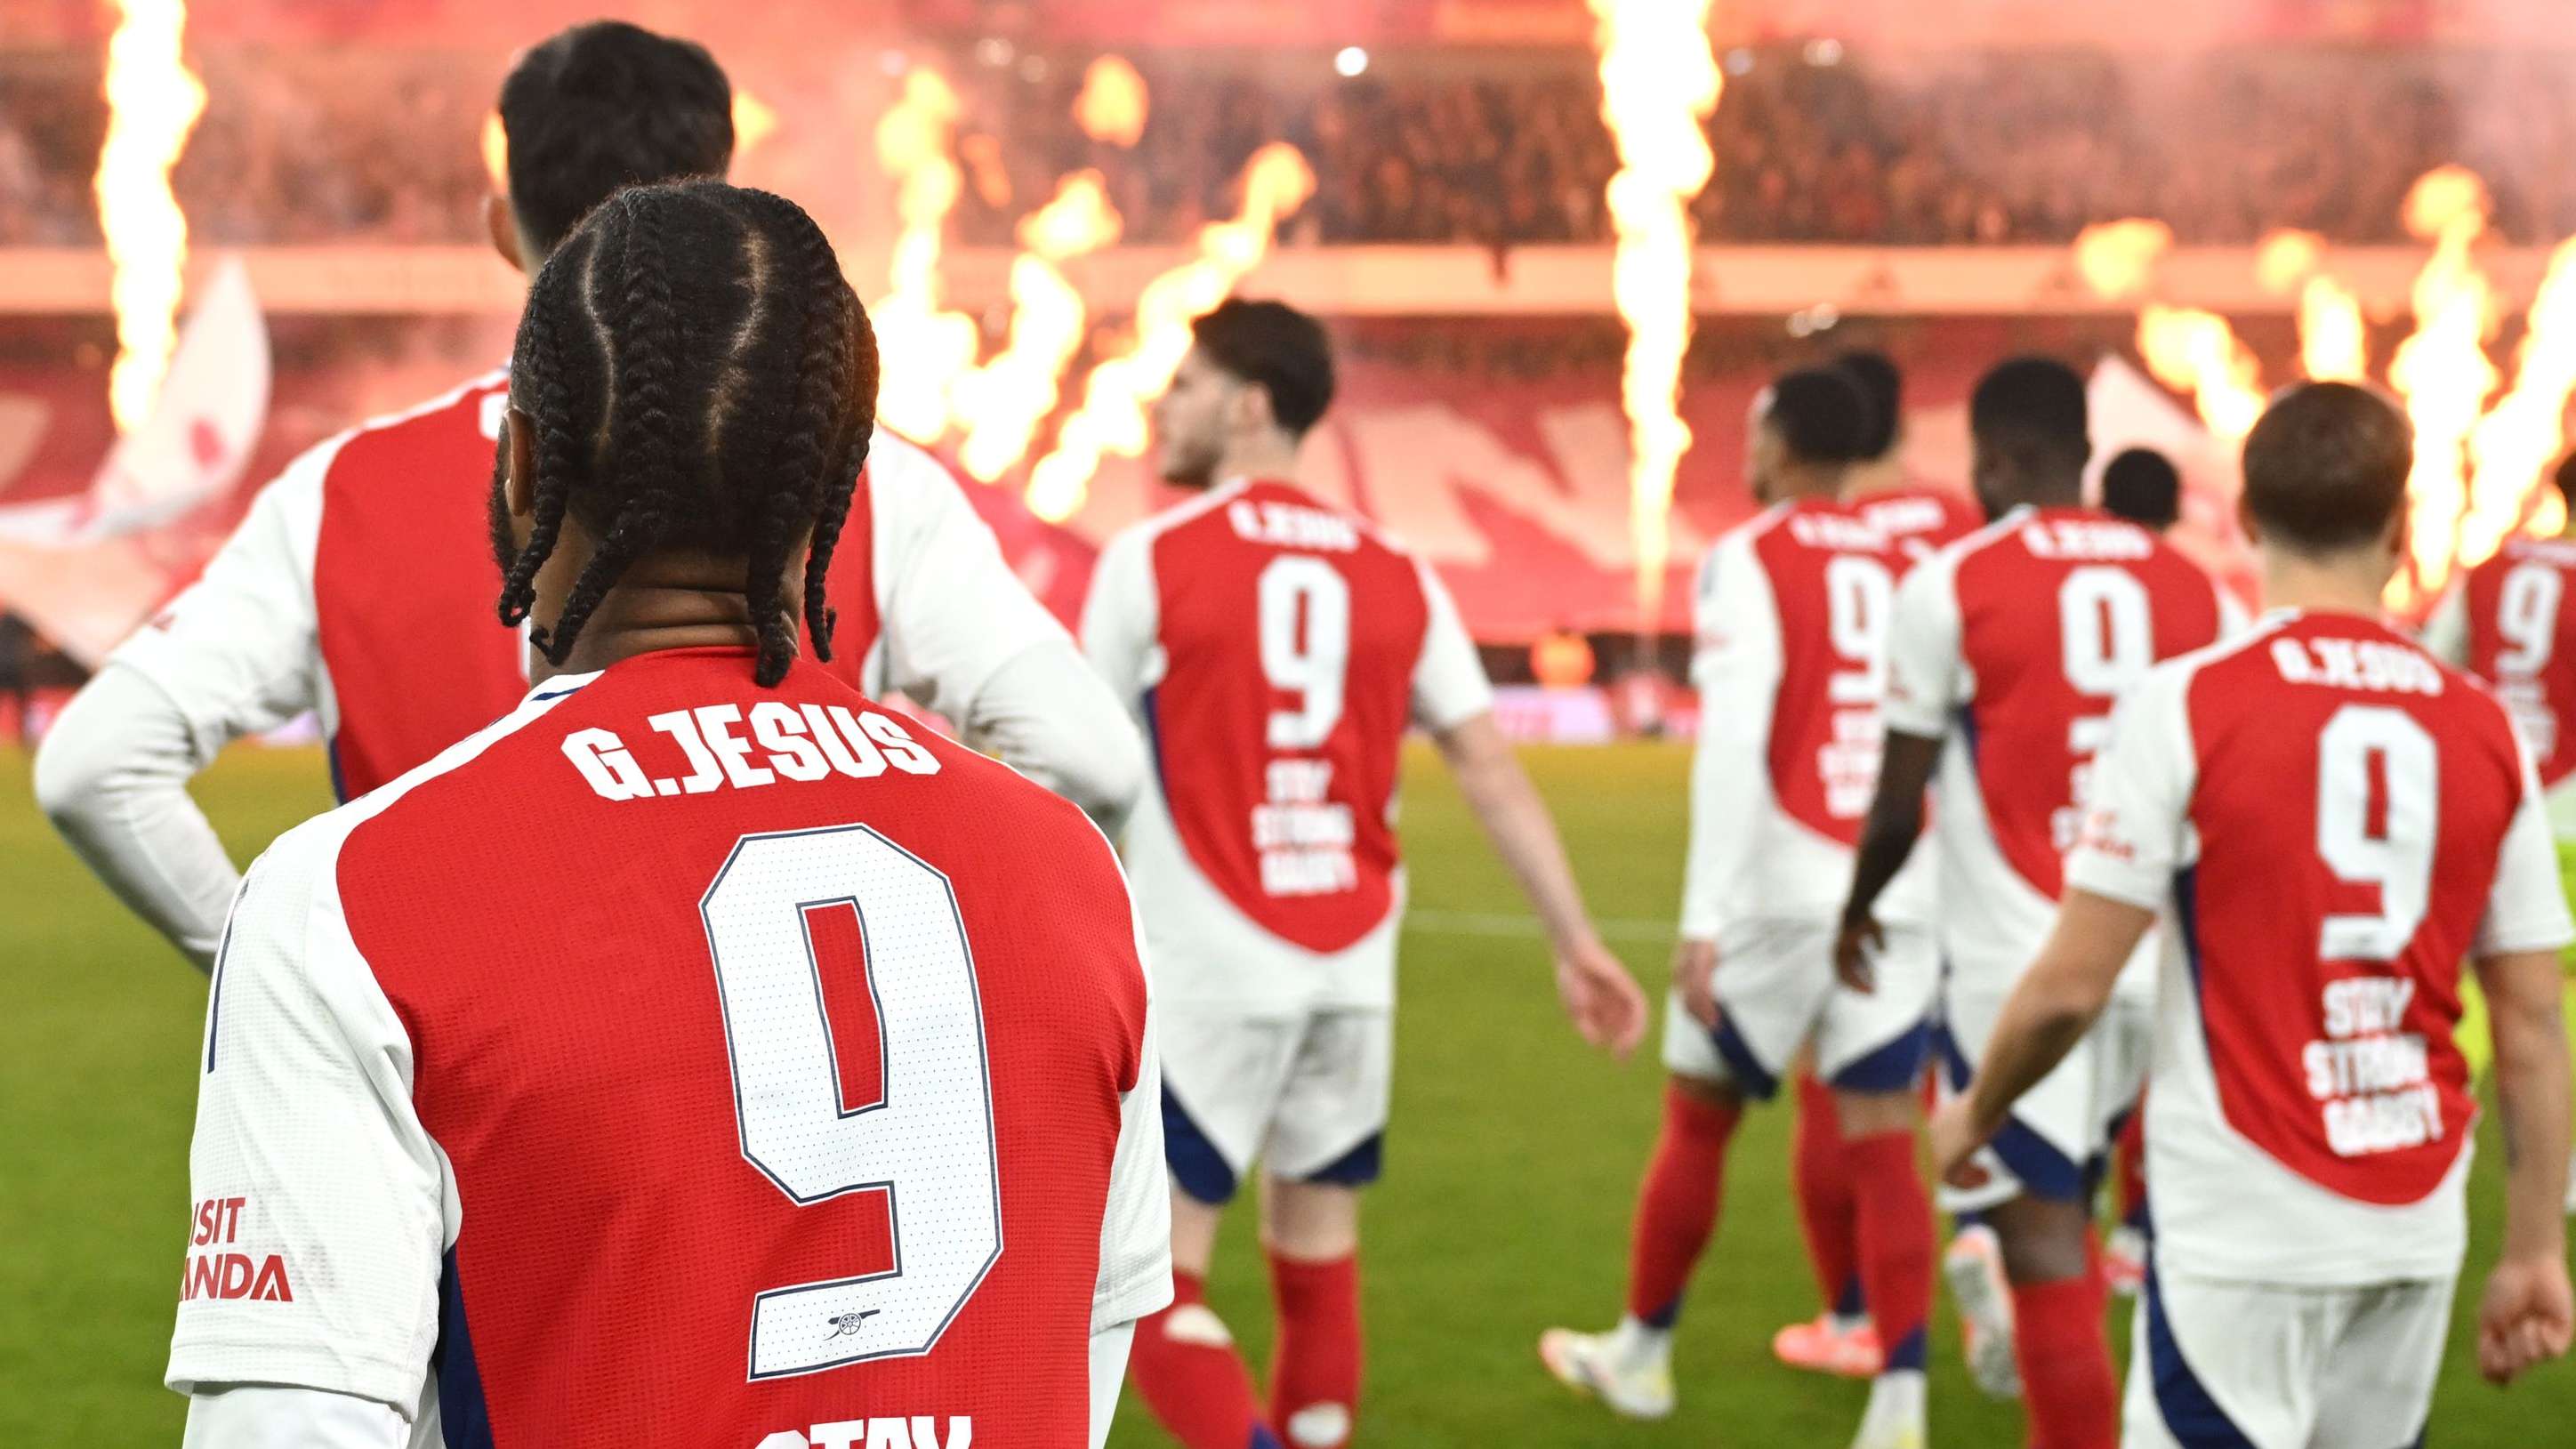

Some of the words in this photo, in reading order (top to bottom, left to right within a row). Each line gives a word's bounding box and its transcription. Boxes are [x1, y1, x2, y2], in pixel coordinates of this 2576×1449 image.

[1258, 554, 1350, 749] 9
[2493, 563, 2564, 676] 9
[560, 701, 942, 801] G.JESUS
[2318, 704, 2438, 960] 9
[698, 823, 1003, 1382] 9
